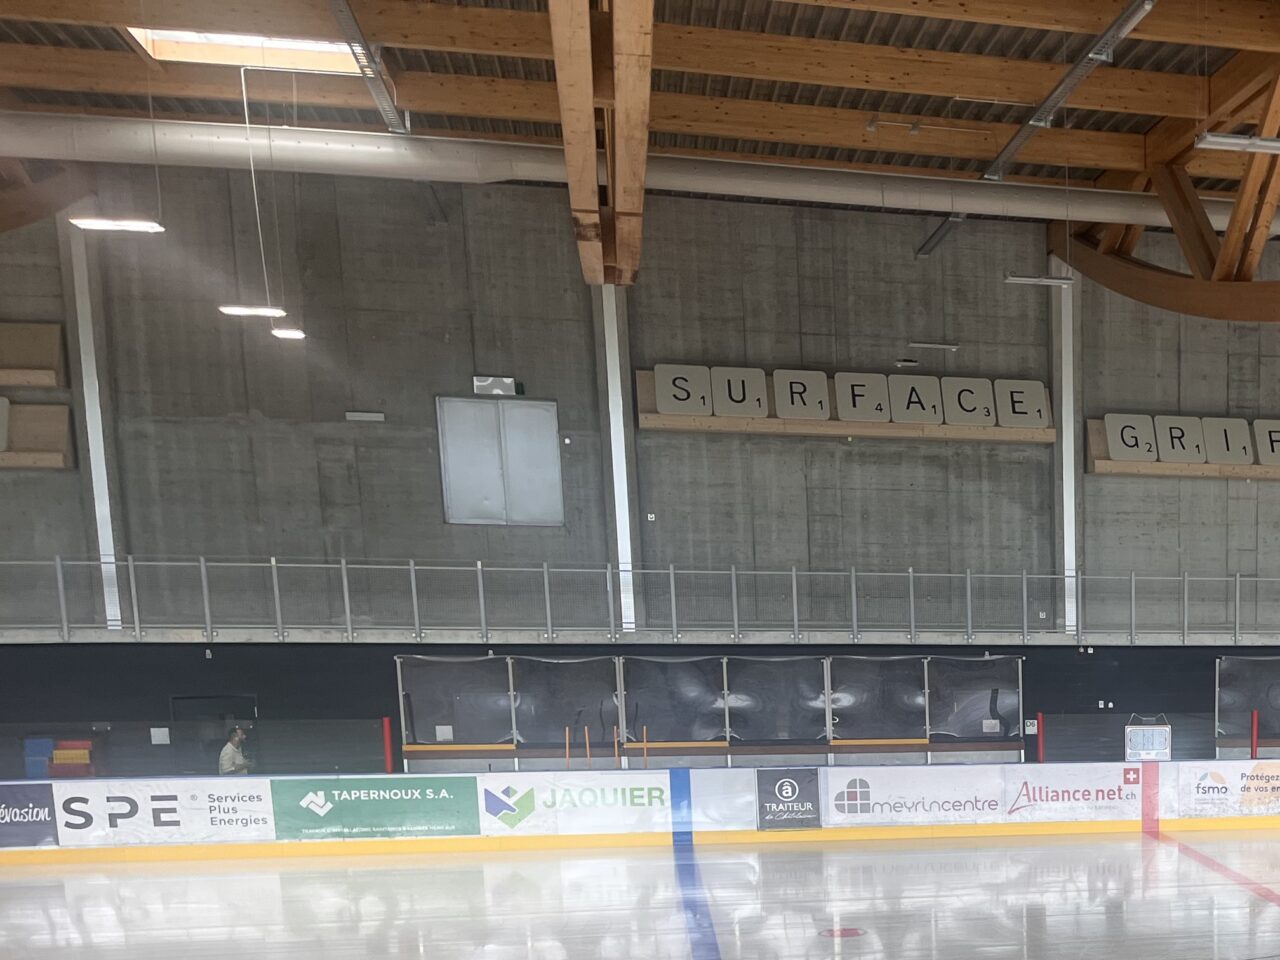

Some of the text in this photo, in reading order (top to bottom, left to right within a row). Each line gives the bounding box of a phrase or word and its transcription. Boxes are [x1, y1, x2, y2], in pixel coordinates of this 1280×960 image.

[671, 376, 1030, 415] SURFACE
[1240, 772, 1280, 783] Protégez
[1195, 783, 1228, 794] fsmo
[1240, 784, 1251, 792] de
[207, 793, 263, 803] Services
[332, 788, 454, 801] TAPERNOUX S.A.
[542, 786, 665, 810] JAQUIER
[209, 805, 238, 814] Plus
[764, 802, 813, 812] TRAITEUR
[871, 796, 999, 815] meyrincentre
[62, 795, 181, 830] SPE
[210, 815, 268, 828] Energies
